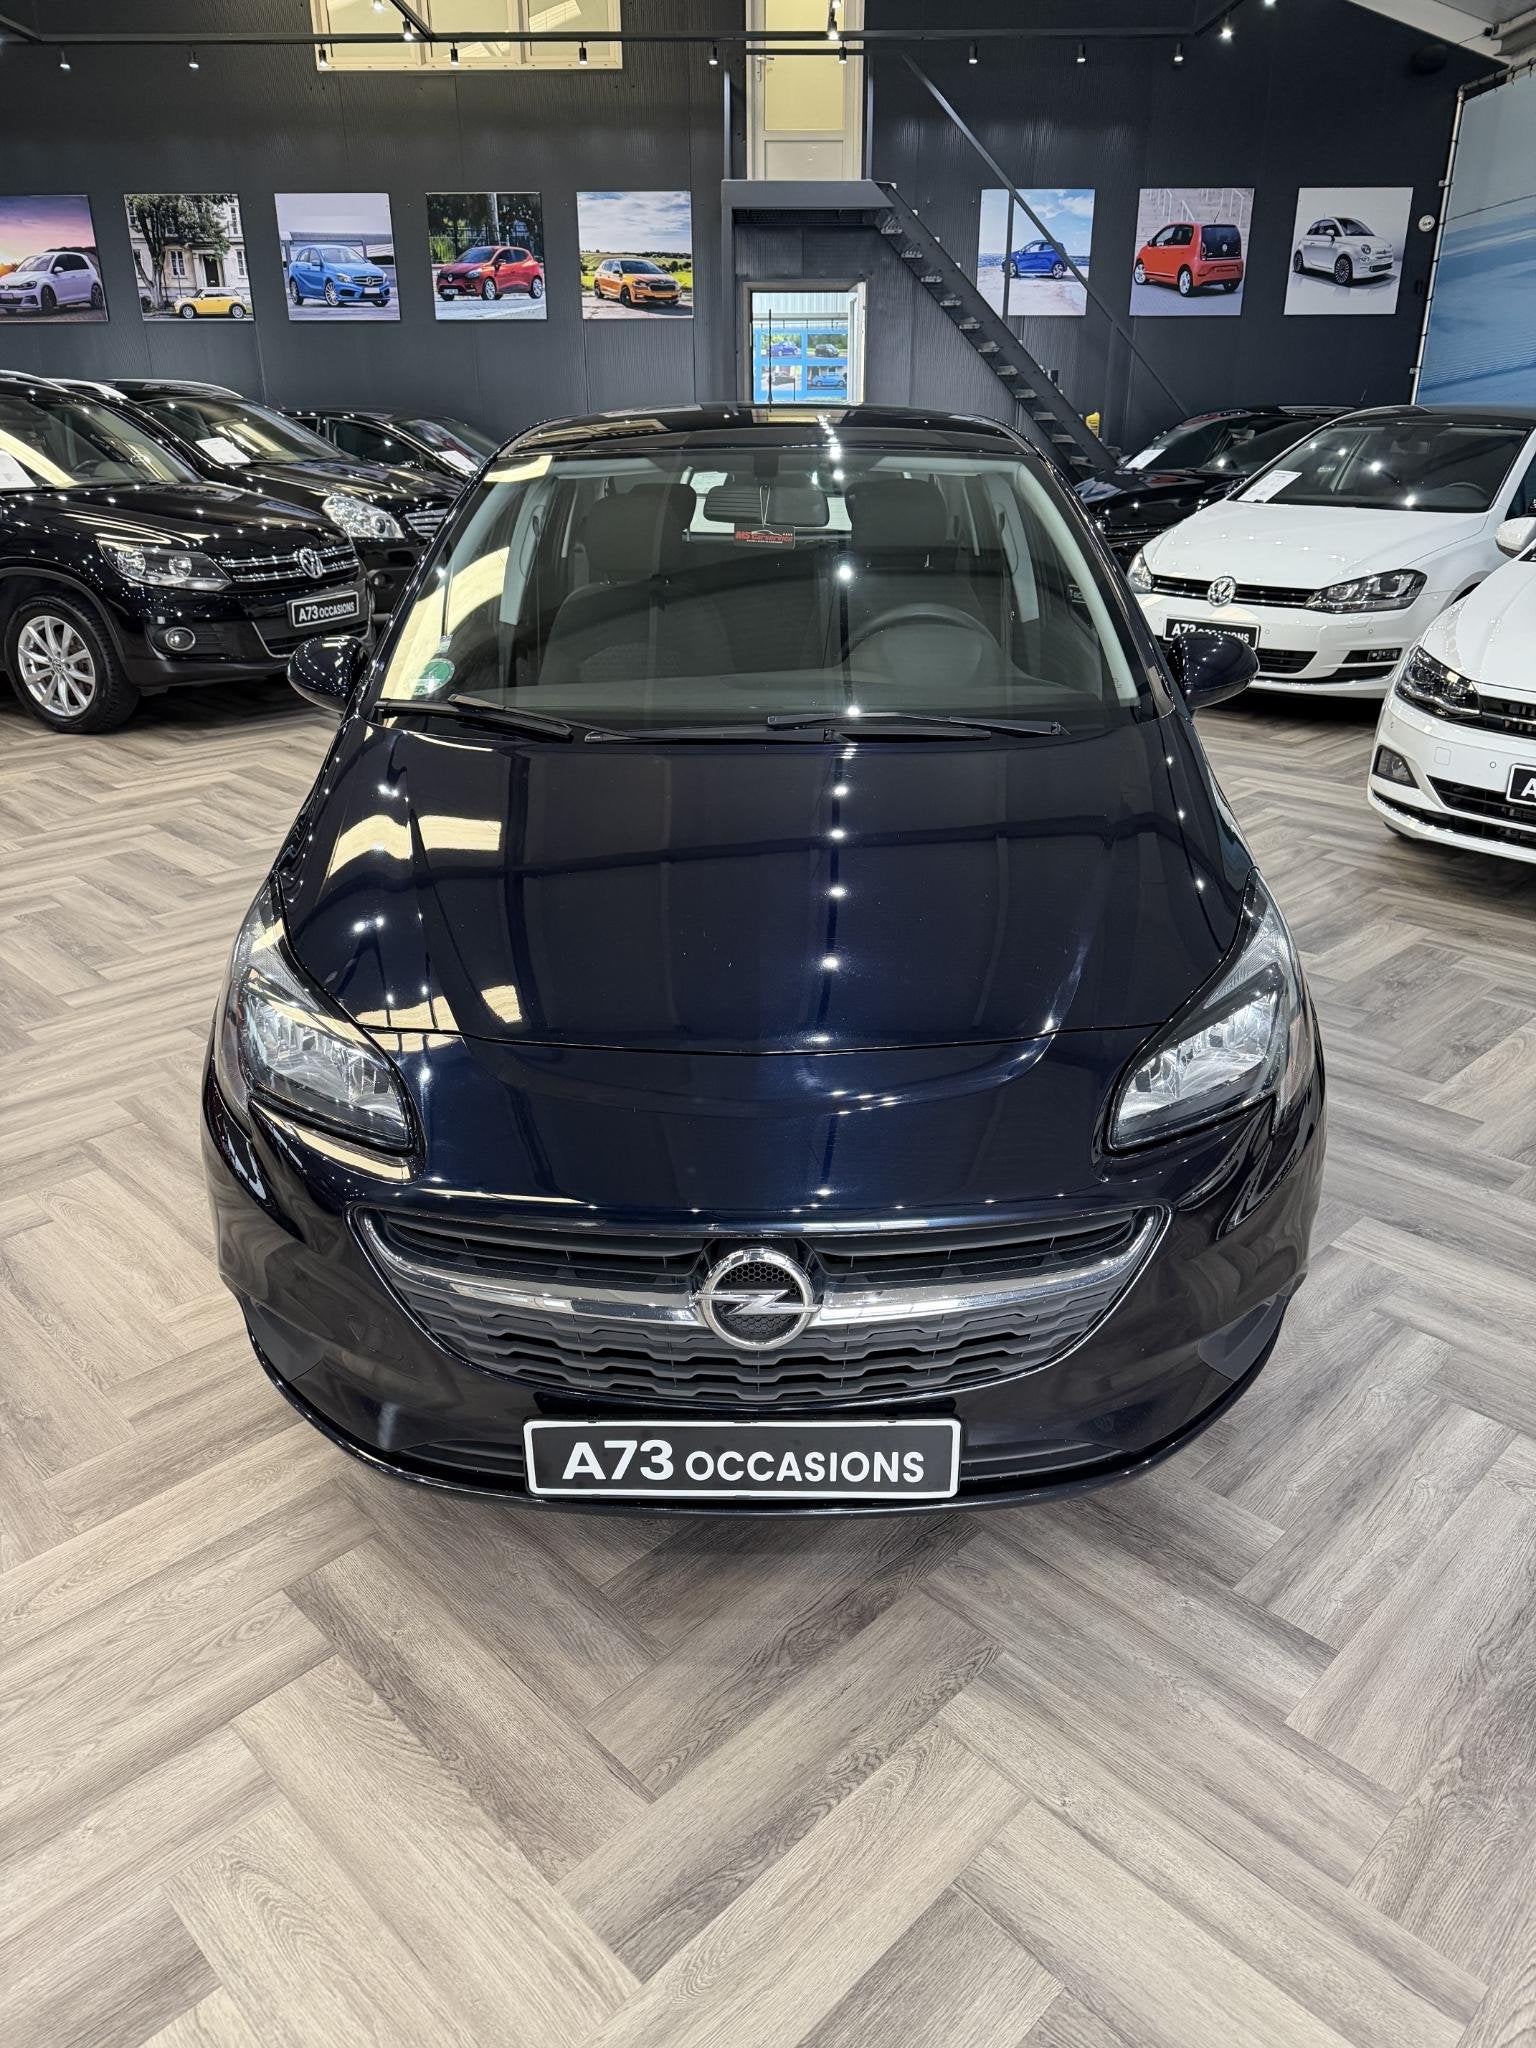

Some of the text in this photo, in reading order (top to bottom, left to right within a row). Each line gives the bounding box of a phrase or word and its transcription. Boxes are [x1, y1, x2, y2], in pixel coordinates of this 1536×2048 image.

[299, 601, 355, 622] A73 OCCASIONS
[561, 1439, 925, 1483] A73 OCCASIONS
